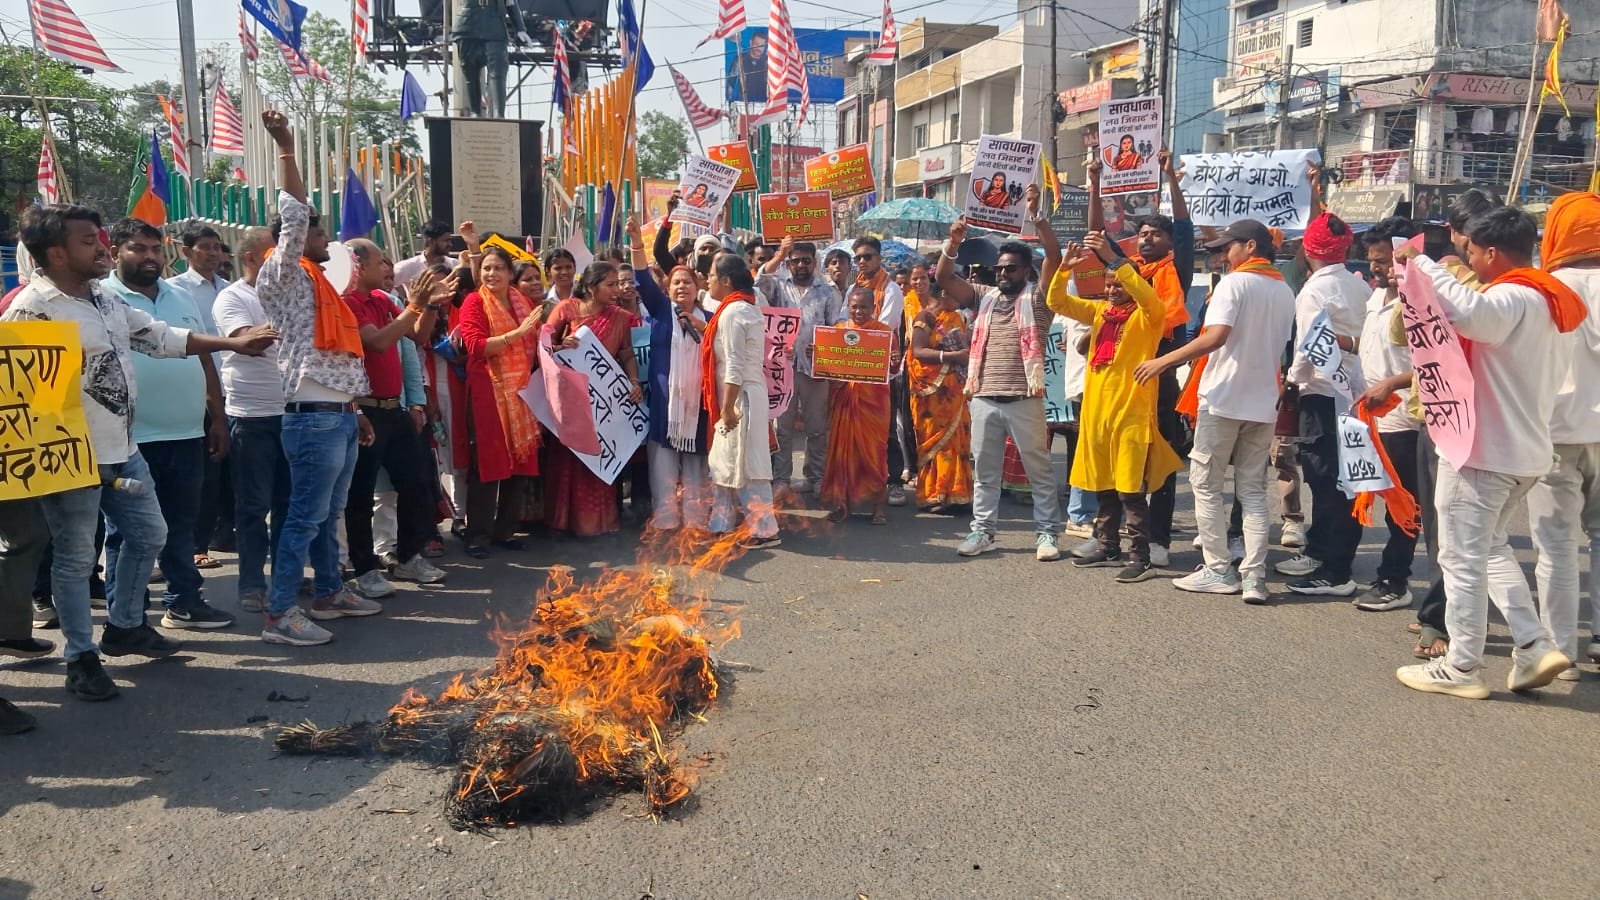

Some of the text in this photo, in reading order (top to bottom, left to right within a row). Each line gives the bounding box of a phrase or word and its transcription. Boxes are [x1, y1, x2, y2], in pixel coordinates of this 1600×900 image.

[1259, 30, 1281, 51] SPORTS
[1462, 77, 1509, 95] RISHI
[1108, 99, 1156, 116] सावधान!
[988, 139, 1036, 155] सावधान!
[698, 159, 736, 178] सावधान!
[1193, 160, 1226, 185] होश
[1226, 160, 1244, 182] में
[765, 207, 783, 220] अवैध
[802, 207, 828, 219] जिहाद
[802, 223, 811, 233] हो
[777, 313, 801, 335] का
[584, 343, 614, 380] लव
[608, 372, 651, 436] जिहाद
